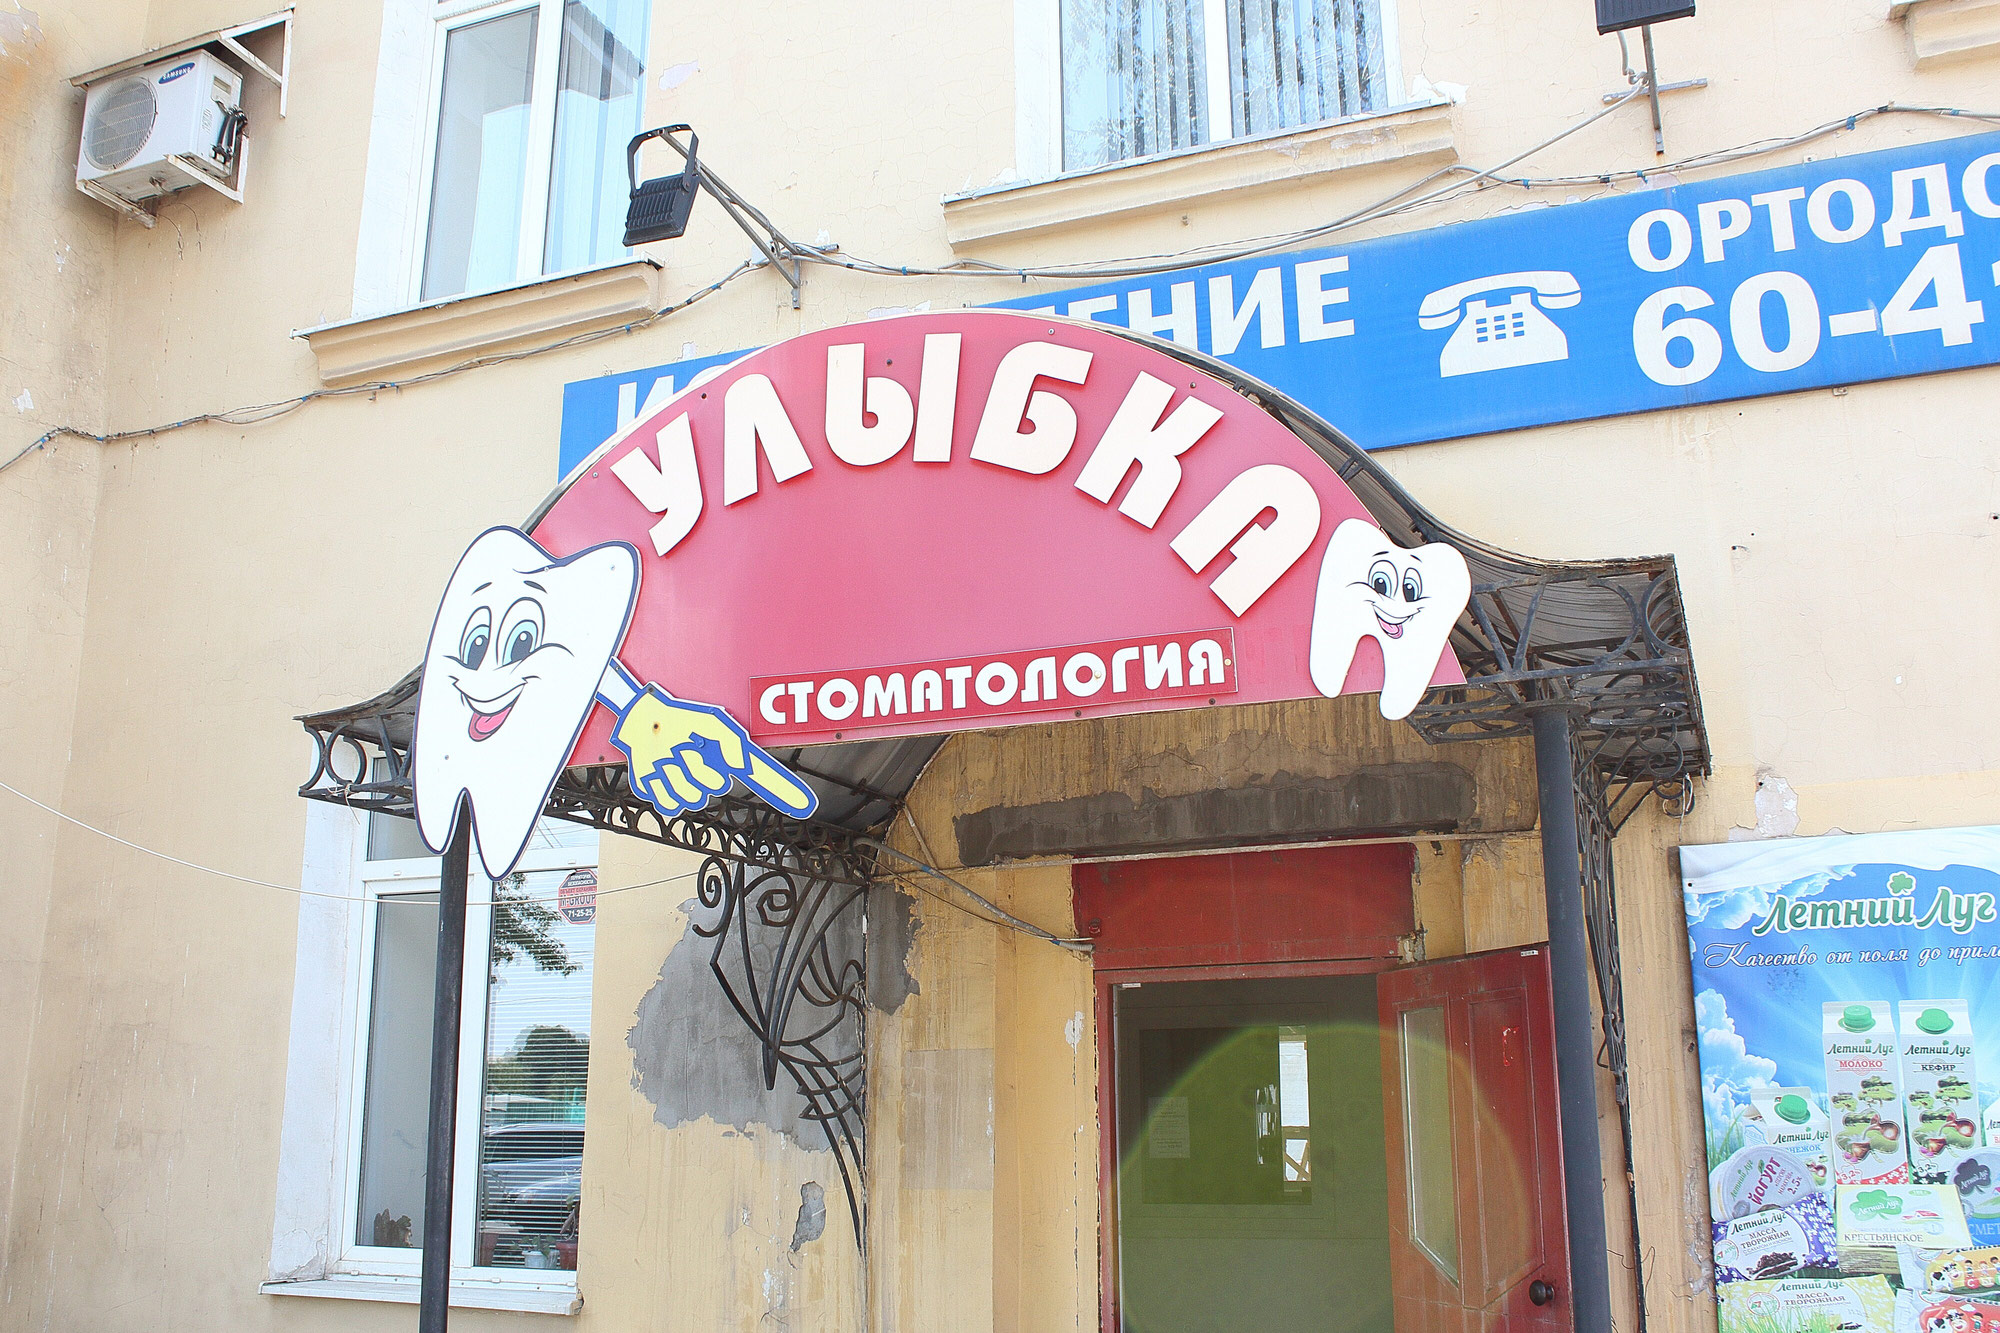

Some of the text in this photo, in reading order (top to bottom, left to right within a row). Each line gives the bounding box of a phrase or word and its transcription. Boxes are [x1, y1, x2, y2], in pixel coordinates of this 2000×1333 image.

[162, 66, 191, 80] SAMSUNG
[1632, 243, 2000, 386] 60-4
[610, 333, 1321, 618] УЛЫБКА
[759, 639, 1226, 726] СТОМАТОЛОГИЯ
[567, 908, 593, 918] 71-25-25
[1752, 887, 1998, 935] Летний Луг
[1703, 942, 1817, 968] Качество
[1826, 951, 1852, 964] от
[1858, 948, 1909, 963] поля
[1918, 946, 1941, 967] до
[1826, 1043, 1894, 1056] Летний Луг
[1904, 1044, 1971, 1057] Летний Луг
[1839, 1060, 1883, 1068] МОЛОКО
[1921, 1064, 1956, 1072] КЕФИР
[1773, 1130, 1829, 1145] Летний Луг
[1786, 1145, 1821, 1154] НЕЖОК
[1748, 1157, 1780, 1205] ЙОГУРТ
[1731, 1212, 1788, 1235] Летний Луг
[1741, 1230, 1790, 1249] ТВОРОЖНАЯ
[1749, 1227, 1777, 1239] МАССА
[1844, 1233, 1924, 1243] КРЕСТЬЯНСКОЕ
[1776, 1280, 1845, 1292] Летний Луг
[1784, 1295, 1845, 1306] ТВОРОЖНАЯ
